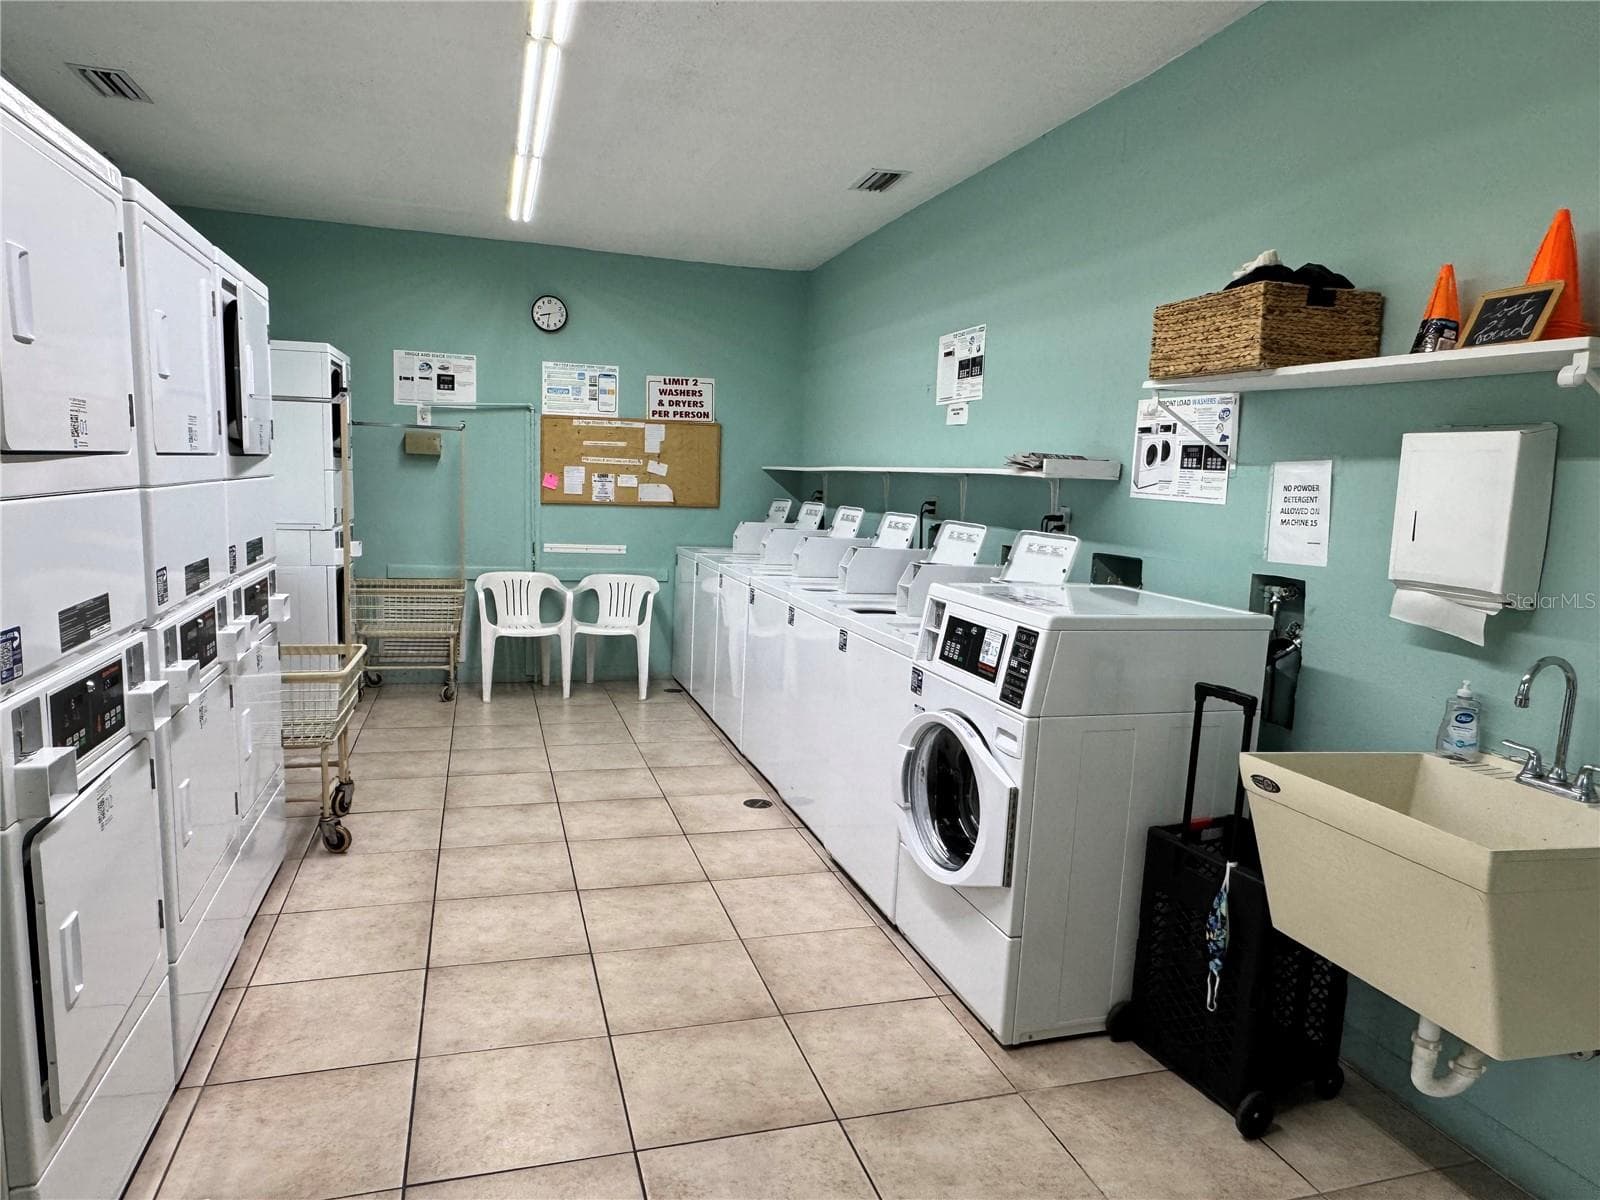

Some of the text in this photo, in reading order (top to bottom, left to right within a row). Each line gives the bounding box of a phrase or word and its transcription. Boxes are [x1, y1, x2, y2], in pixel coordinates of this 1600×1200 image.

[663, 378, 690, 386] LIMIT
[658, 388, 703, 397] WASHERS
[668, 400, 704, 408] DRYERS
[673, 410, 710, 419] PERSON
